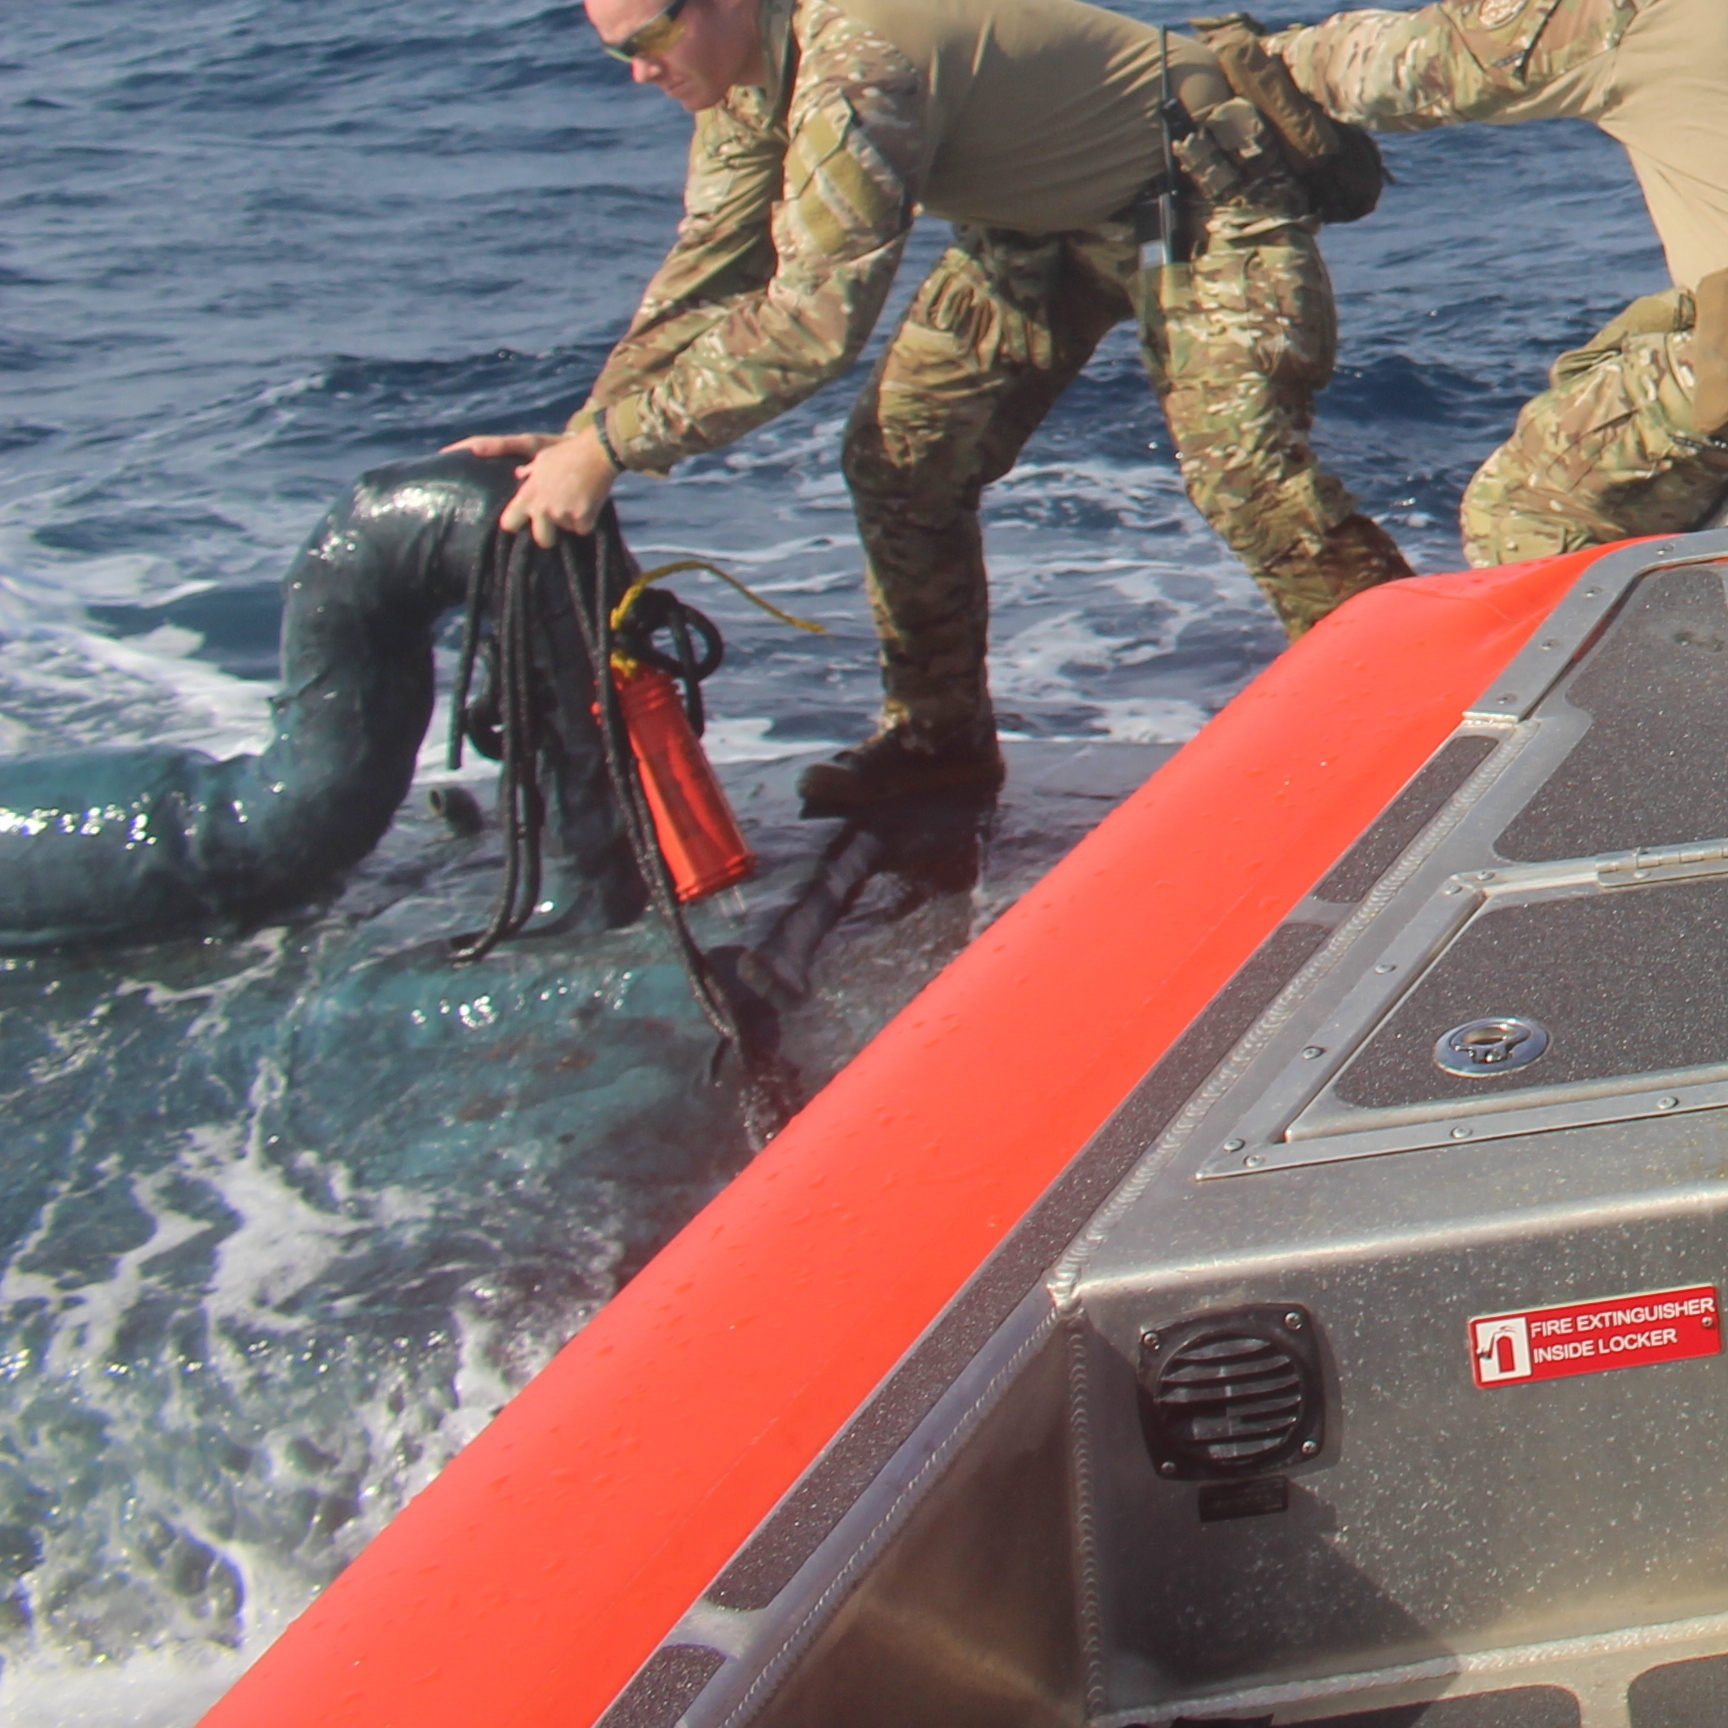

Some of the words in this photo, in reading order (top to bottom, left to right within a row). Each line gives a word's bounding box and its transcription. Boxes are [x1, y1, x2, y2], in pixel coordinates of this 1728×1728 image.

[1530, 1317, 1574, 1339] FIRE
[1576, 1296, 1715, 1330] EXTINGUISHER
[1533, 1339, 1596, 1364] INSIDE
[1598, 1327, 1678, 1355] LOCKER
